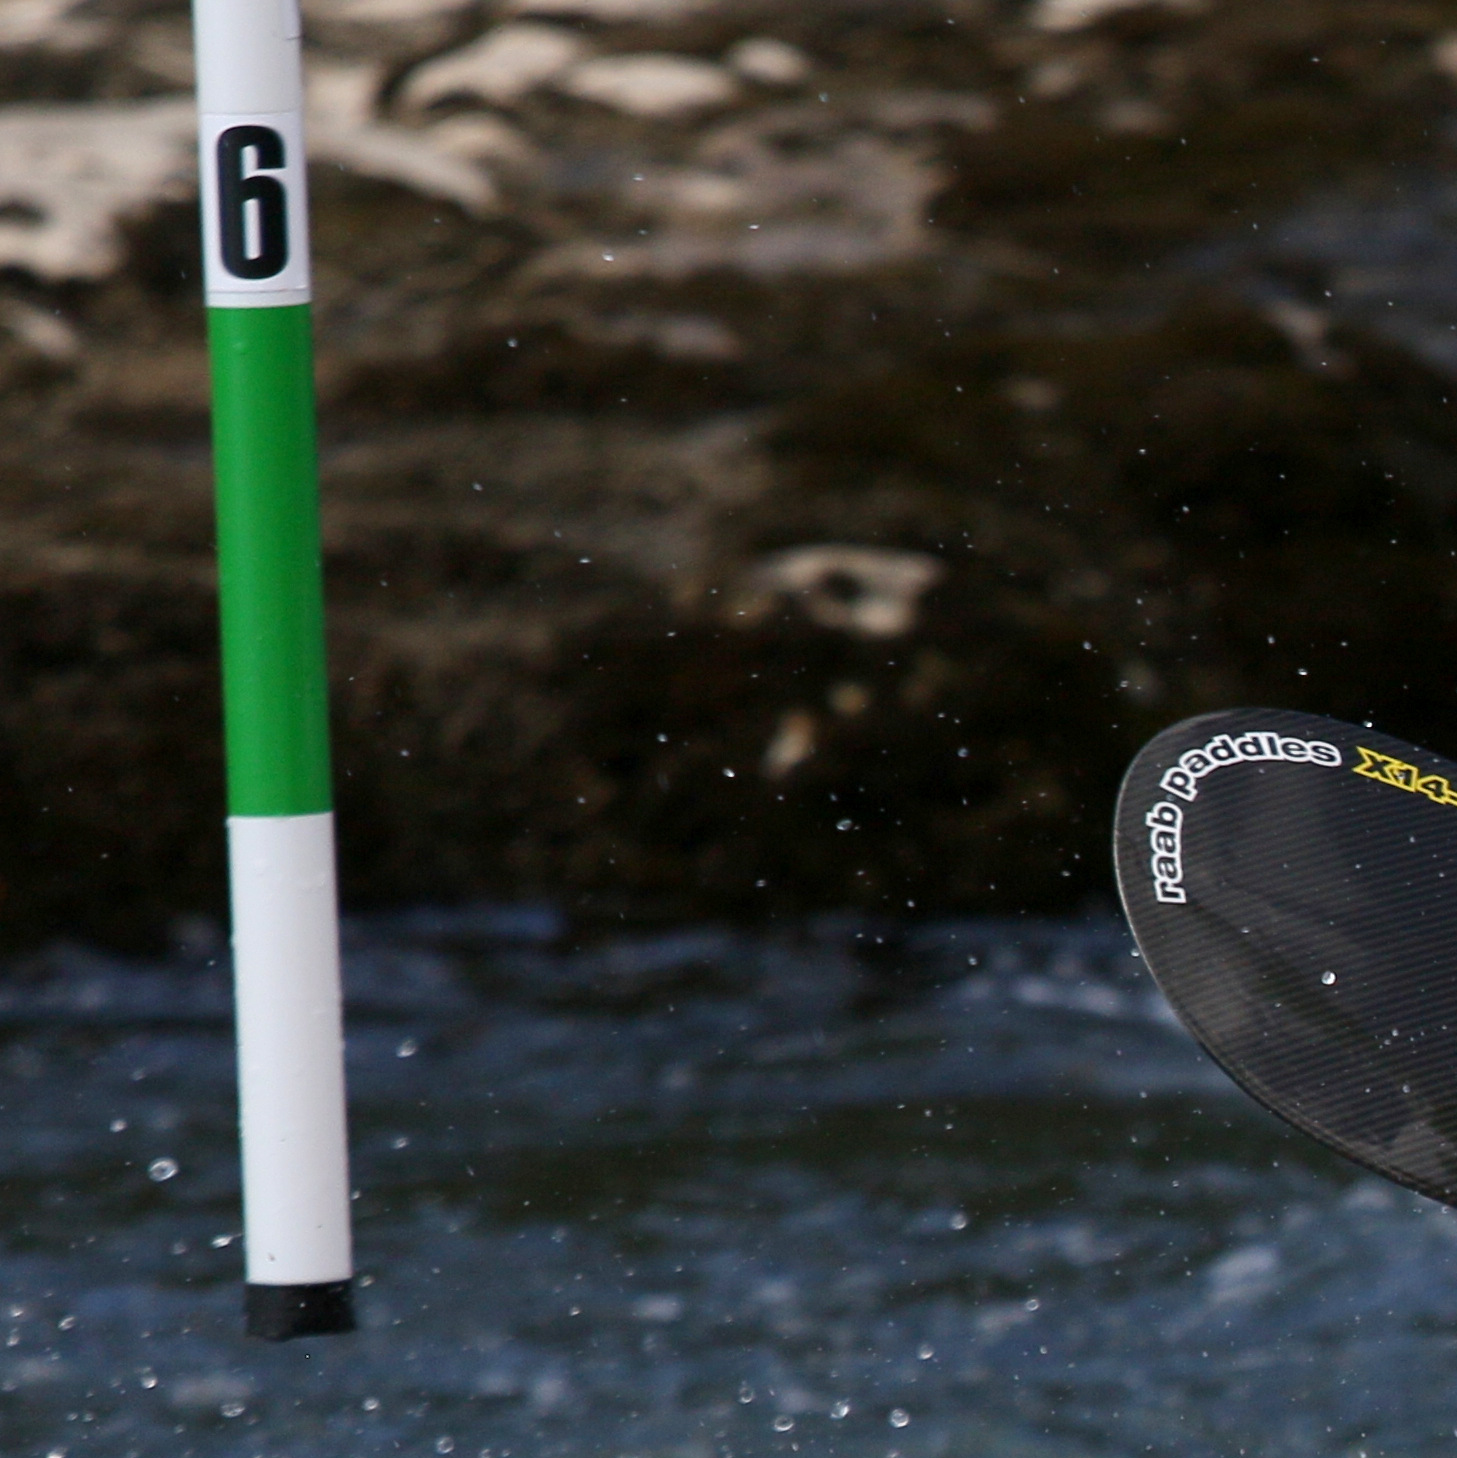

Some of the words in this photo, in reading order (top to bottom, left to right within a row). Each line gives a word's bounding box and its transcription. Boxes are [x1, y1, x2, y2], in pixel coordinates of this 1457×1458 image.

[216, 125, 290, 281] 6
[1159, 731, 1343, 802] paddles
[1145, 801, 1187, 904] raab
